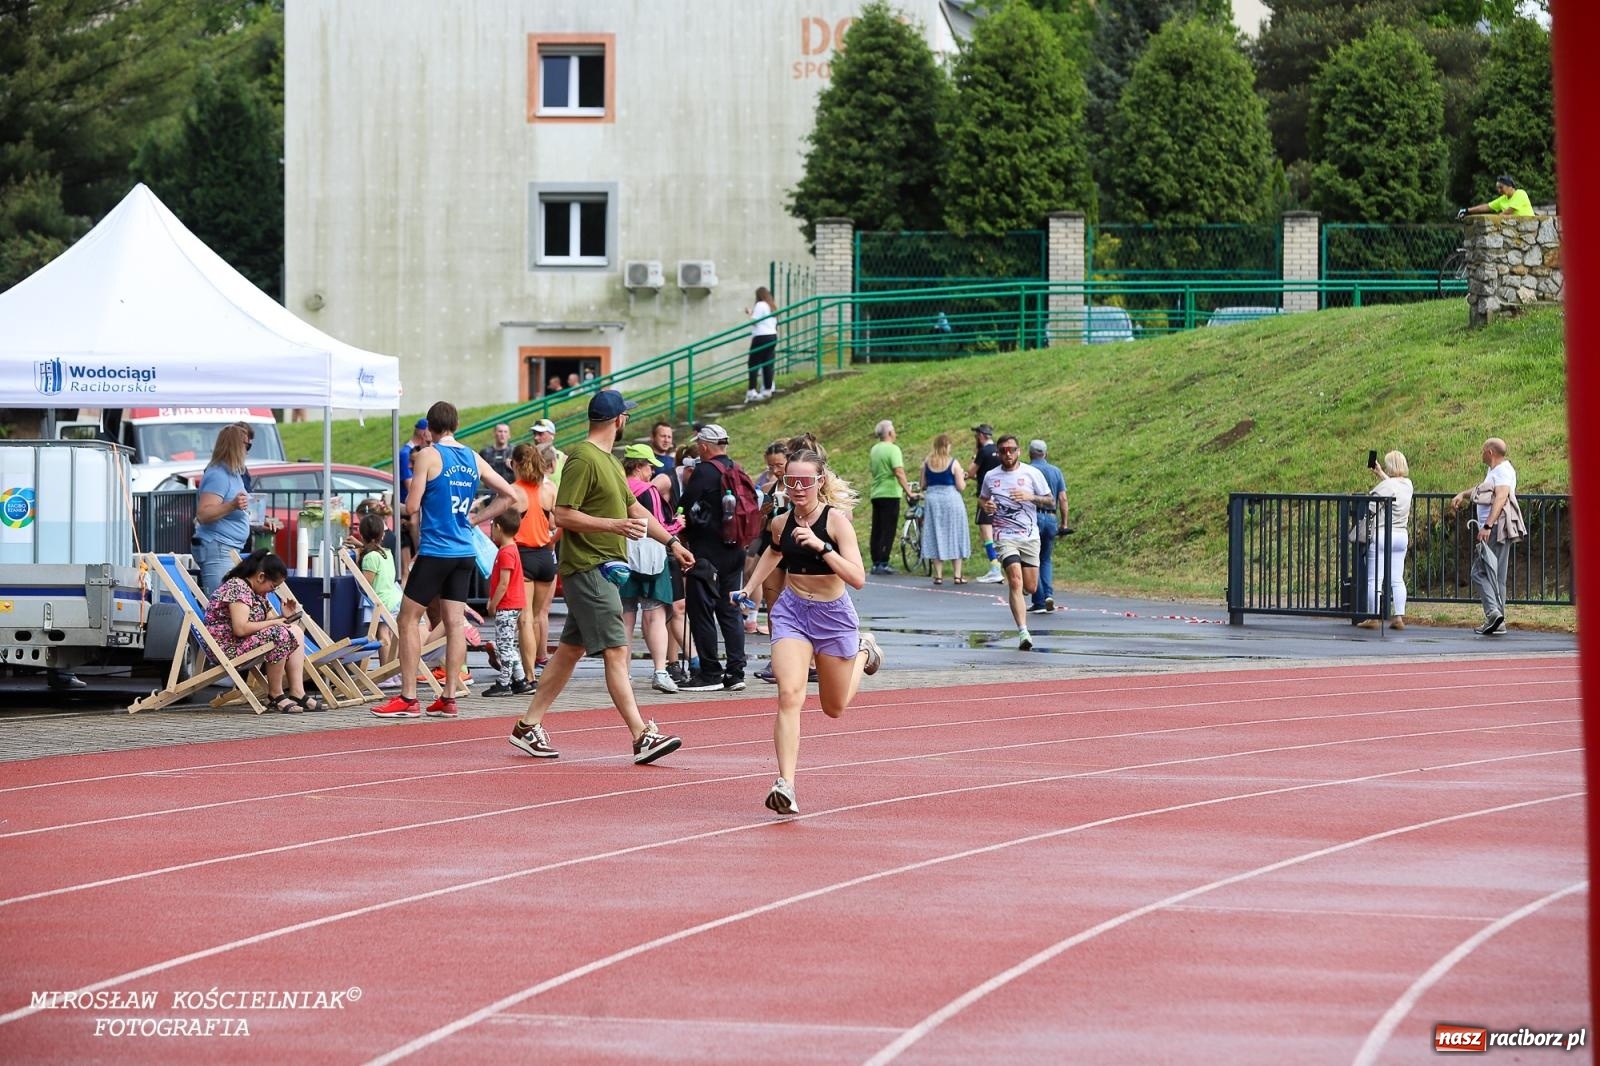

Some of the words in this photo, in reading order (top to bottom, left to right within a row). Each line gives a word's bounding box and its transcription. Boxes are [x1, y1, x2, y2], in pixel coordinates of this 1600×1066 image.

[69, 365, 156, 382] Wodociągi
[70, 381, 157, 393] Raciborskie
[444, 464, 478, 481] VICTORIA
[451, 495, 470, 515] 24
